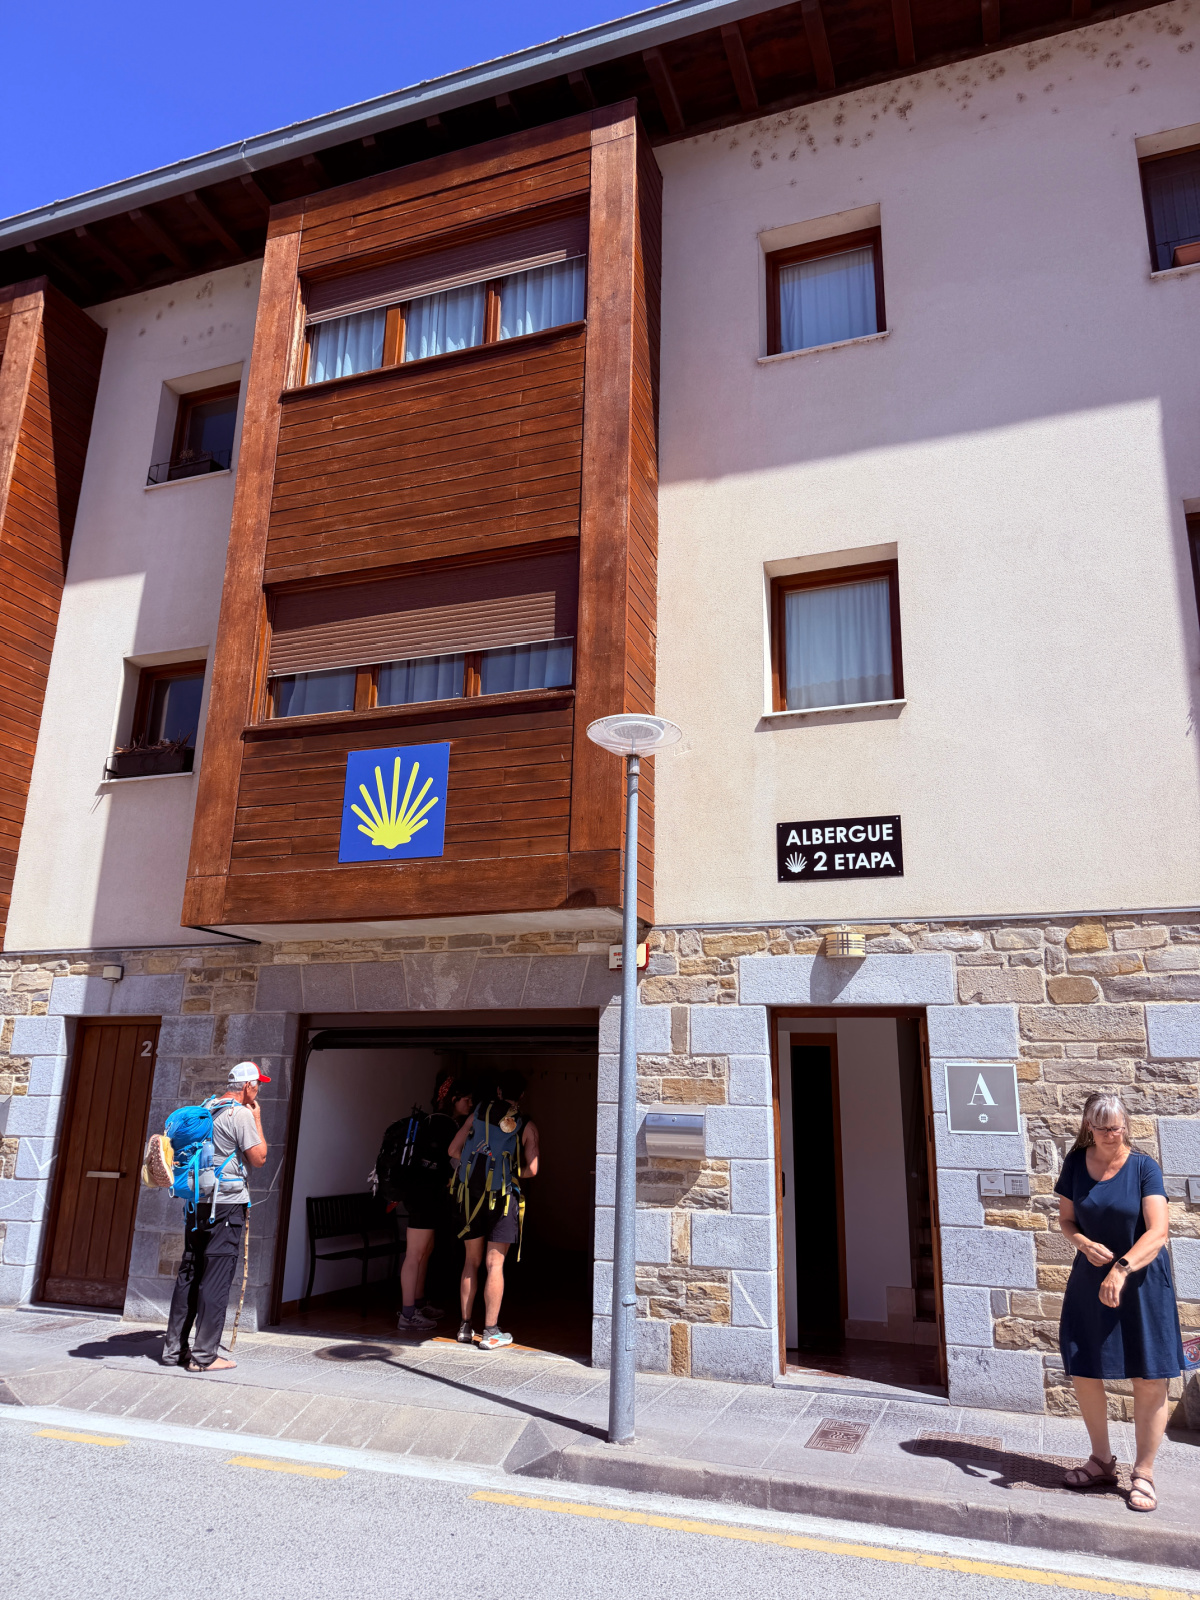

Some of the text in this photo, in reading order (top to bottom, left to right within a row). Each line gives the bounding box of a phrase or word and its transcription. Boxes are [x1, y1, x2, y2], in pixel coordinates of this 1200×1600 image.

[786, 823, 893, 846] ALBERGUE
[813, 851, 896, 872] 2 ETAPA
[141, 1040, 153, 1057] 2
[966, 1072, 999, 1106] A
